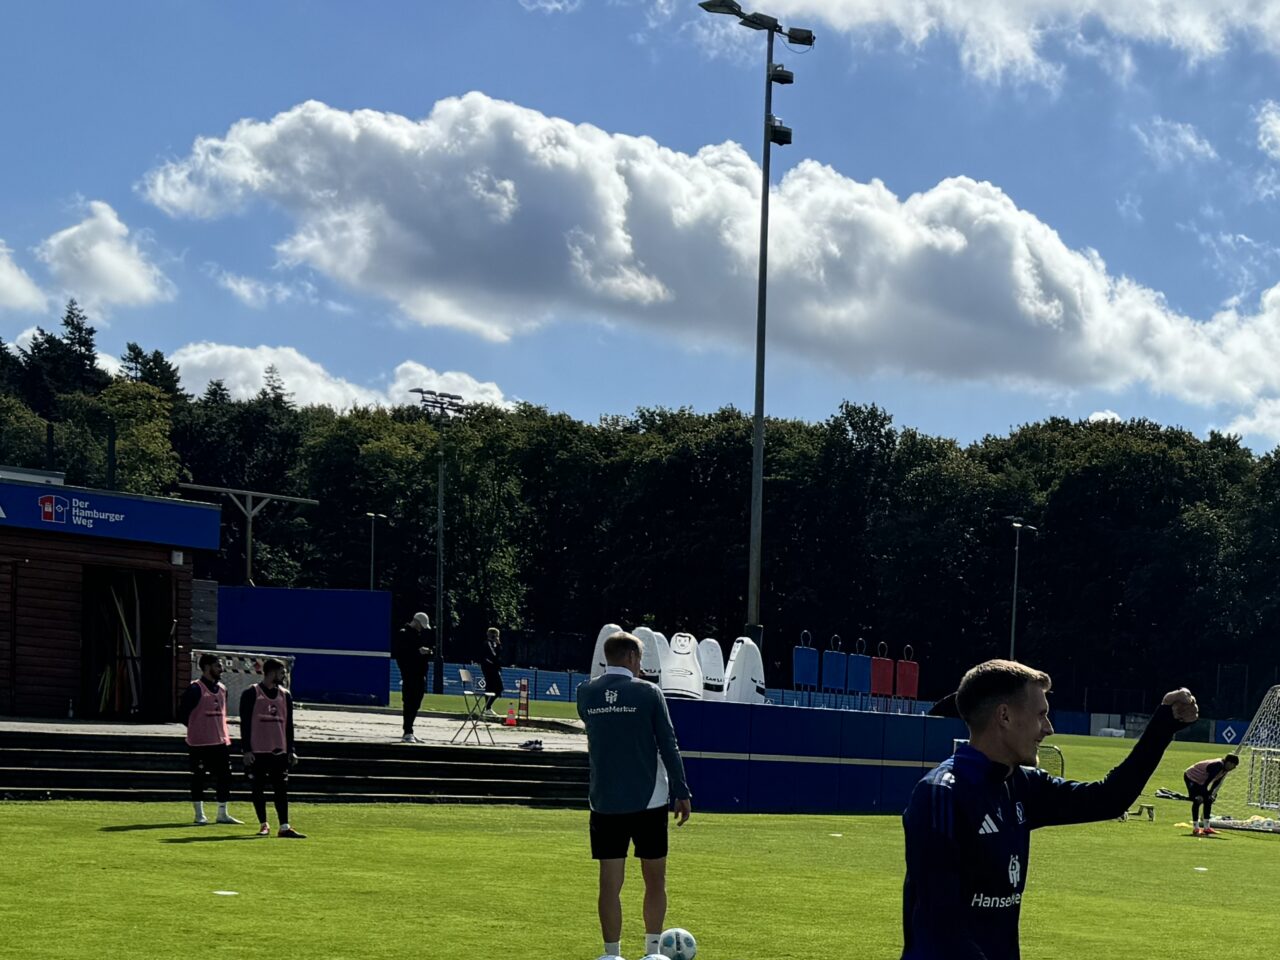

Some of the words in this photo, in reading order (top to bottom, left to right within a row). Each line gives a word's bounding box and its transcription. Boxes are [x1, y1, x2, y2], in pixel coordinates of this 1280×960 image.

[72, 498, 90, 508] Der
[72, 507, 125, 521] Hamburger
[72, 516, 94, 528] Weg
